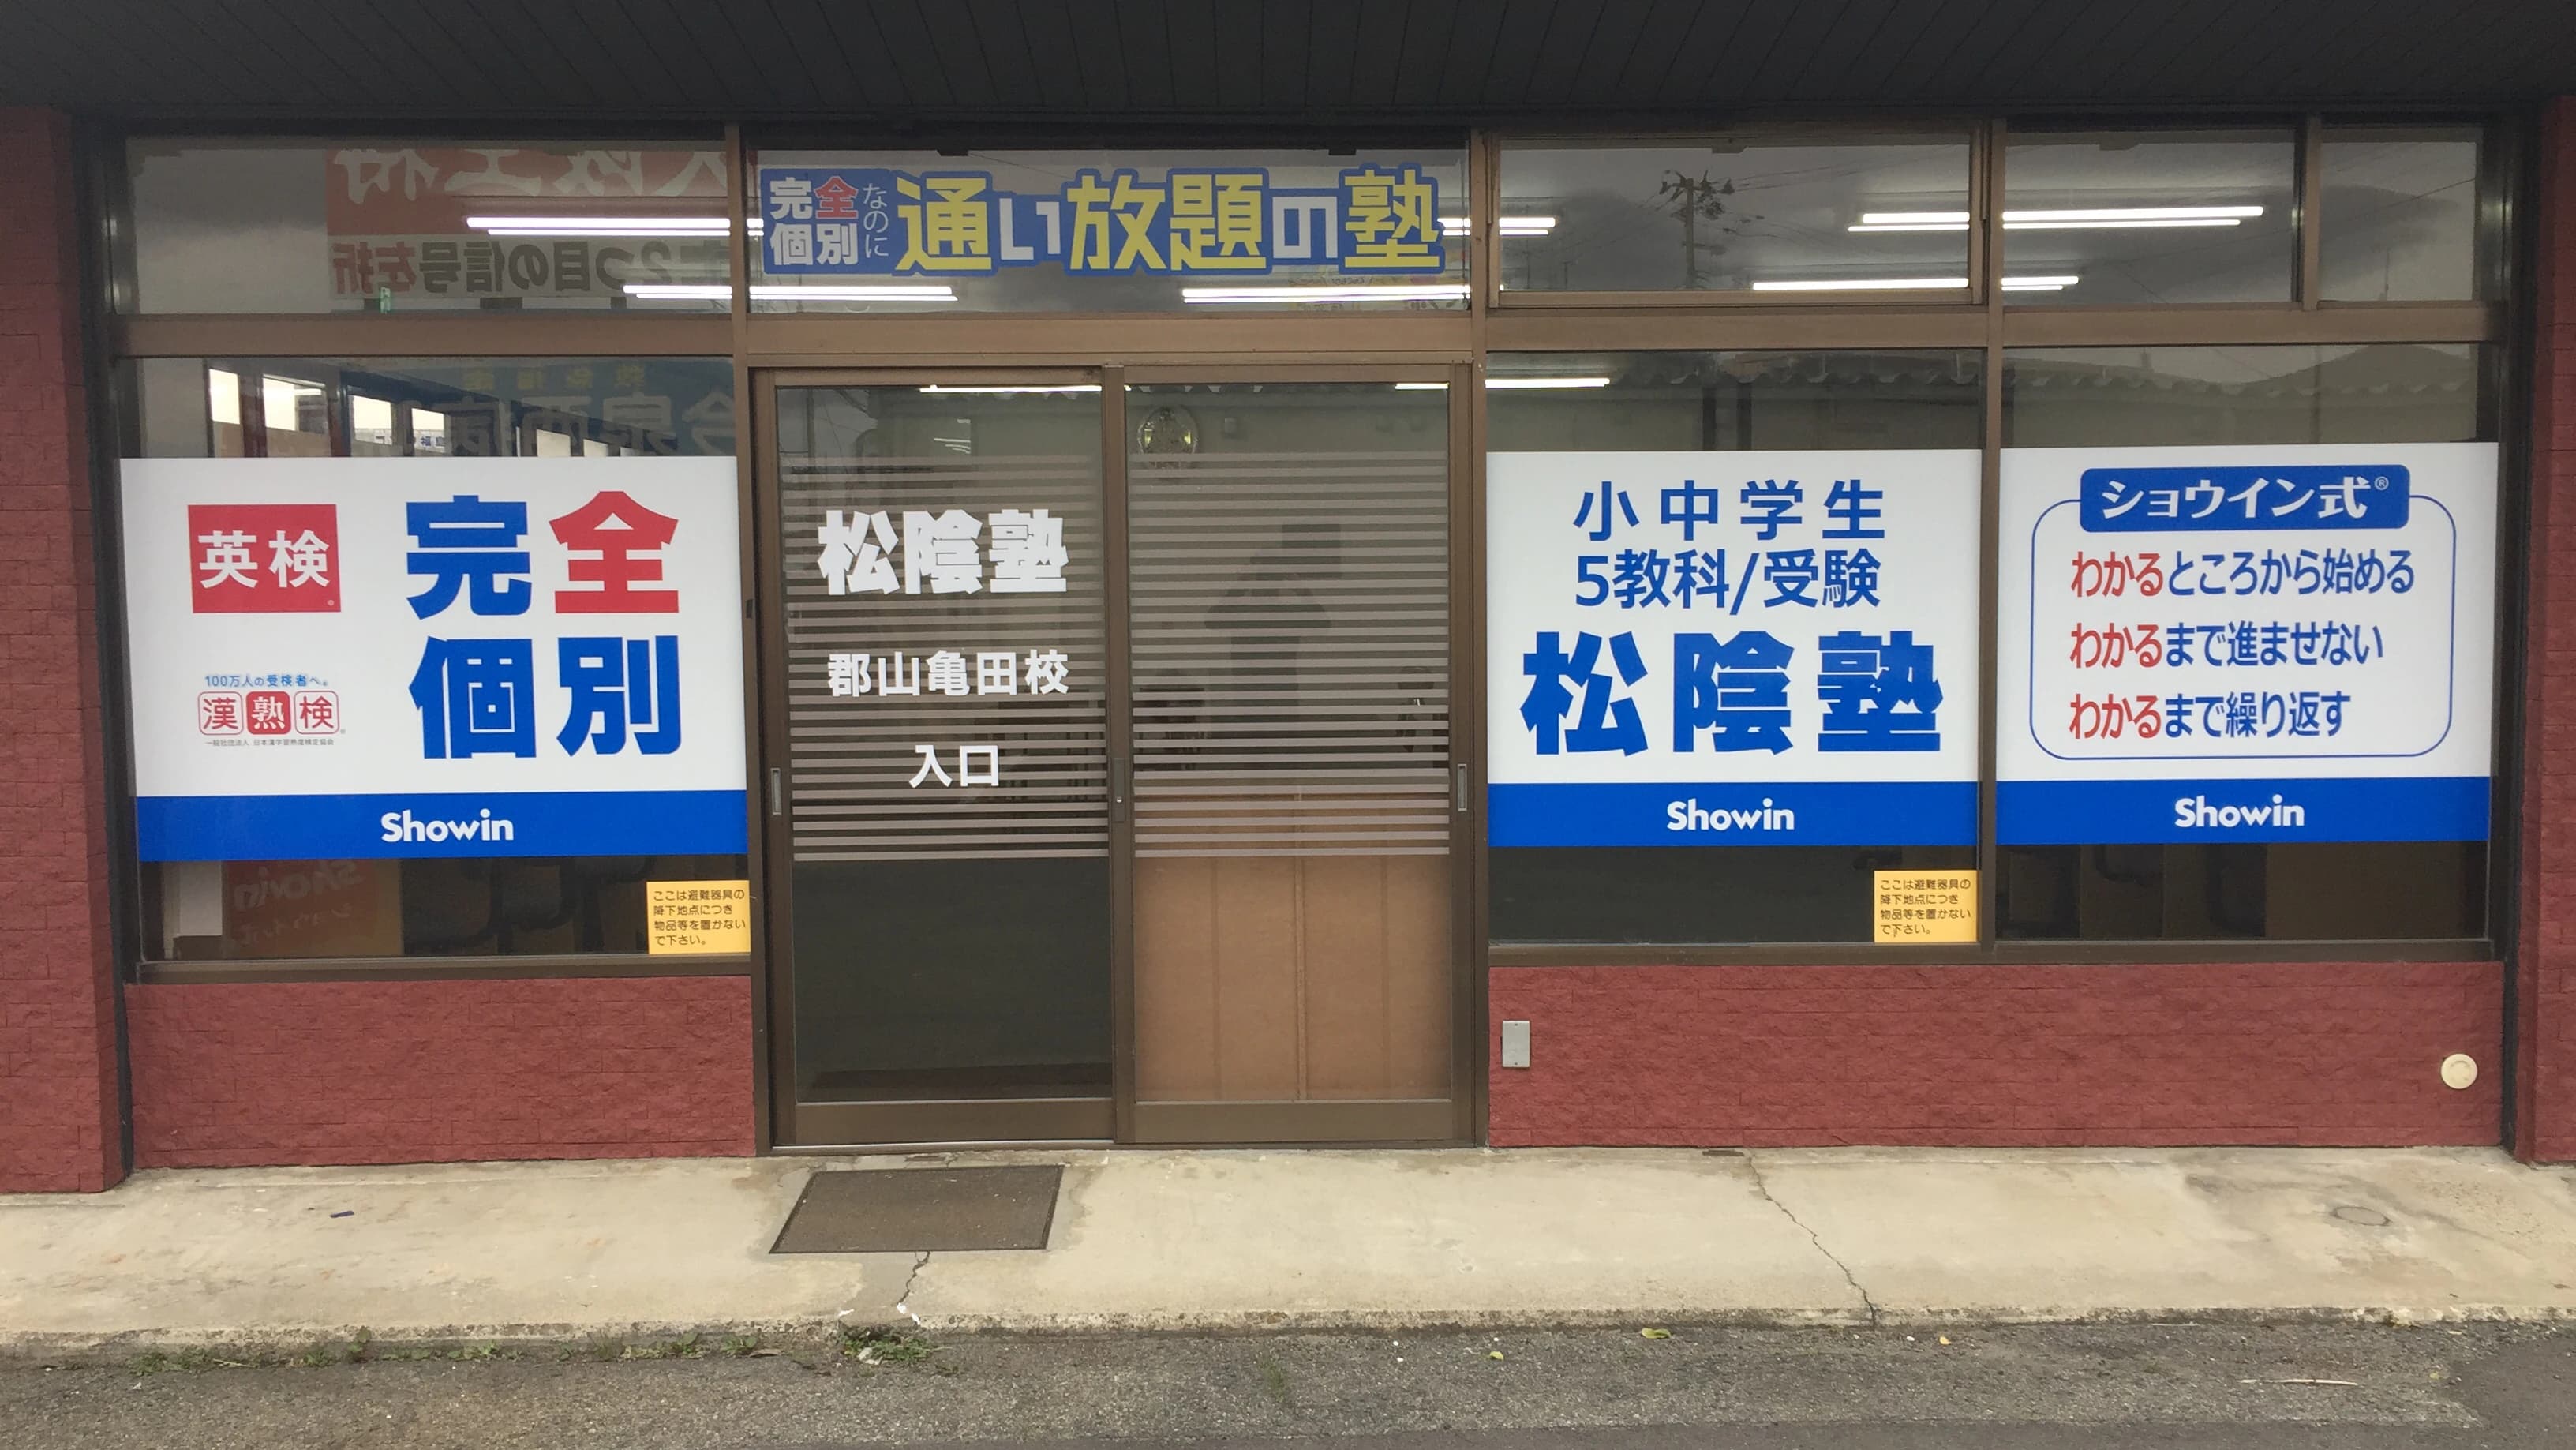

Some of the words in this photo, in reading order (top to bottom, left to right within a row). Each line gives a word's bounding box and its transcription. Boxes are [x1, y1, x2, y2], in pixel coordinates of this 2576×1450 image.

[769, 175, 859, 220] 完全
[863, 182, 889, 258] なのに
[894, 169, 1441, 270] 通い放題の塾
[769, 223, 859, 266] 個別
[1573, 479, 1885, 542] 小中学生
[197, 530, 330, 589] 英検
[405, 490, 680, 620] 完全
[817, 508, 1069, 595] 松陰塾
[2070, 549, 2414, 598] わかるところから始める
[1575, 548, 1881, 616] 5教科/受験
[2069, 620, 2384, 669] わかるまで進ませない
[408, 635, 682, 759] 個別
[827, 649, 1069, 697] 郡山亀田校
[1520, 630, 1944, 756] 松陰塾
[202, 696, 334, 730] 漢熟検
[2069, 691, 2351, 739] わかるまで繰り返す
[908, 744, 1000, 788] 入口
[381, 808, 514, 842] Showin
[1667, 798, 1795, 831] Showin
[2174, 794, 2305, 828] Showin
[655, 935, 706, 946] で下さい。
[1881, 924, 1931, 937] で下さい。
